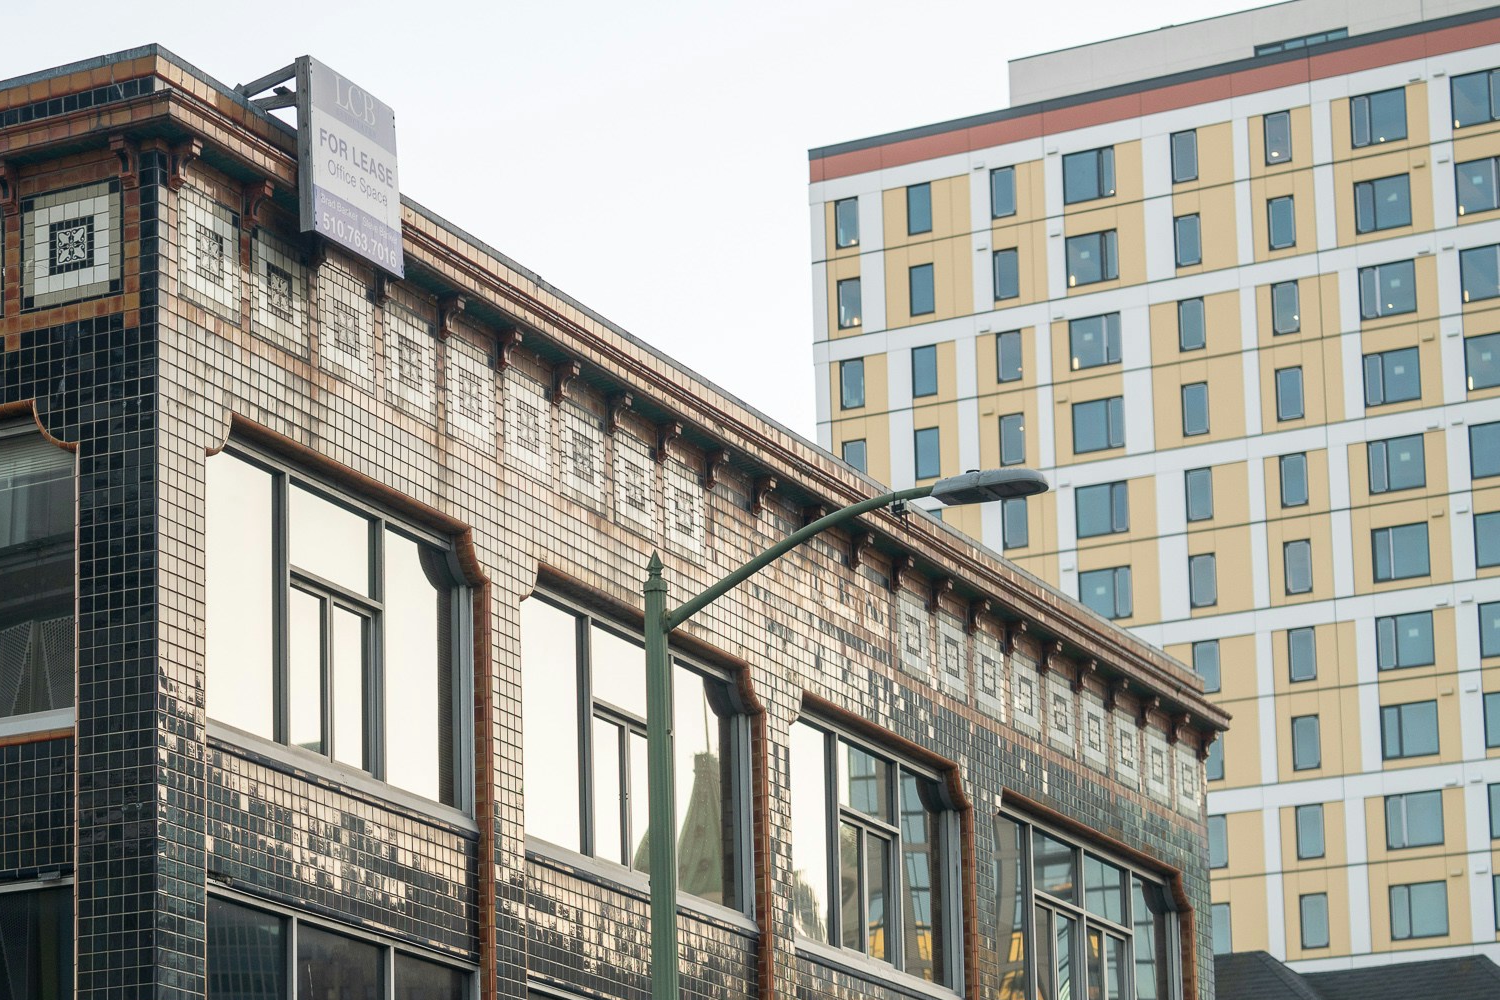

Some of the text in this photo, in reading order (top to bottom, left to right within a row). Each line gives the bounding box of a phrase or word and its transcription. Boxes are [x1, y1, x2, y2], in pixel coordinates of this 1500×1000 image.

[334, 75, 375, 126] LCB
[320, 128, 393, 189] FOR LEASE
[328, 160, 388, 207] Office Space
[323, 212, 397, 268] 510.763.7016
